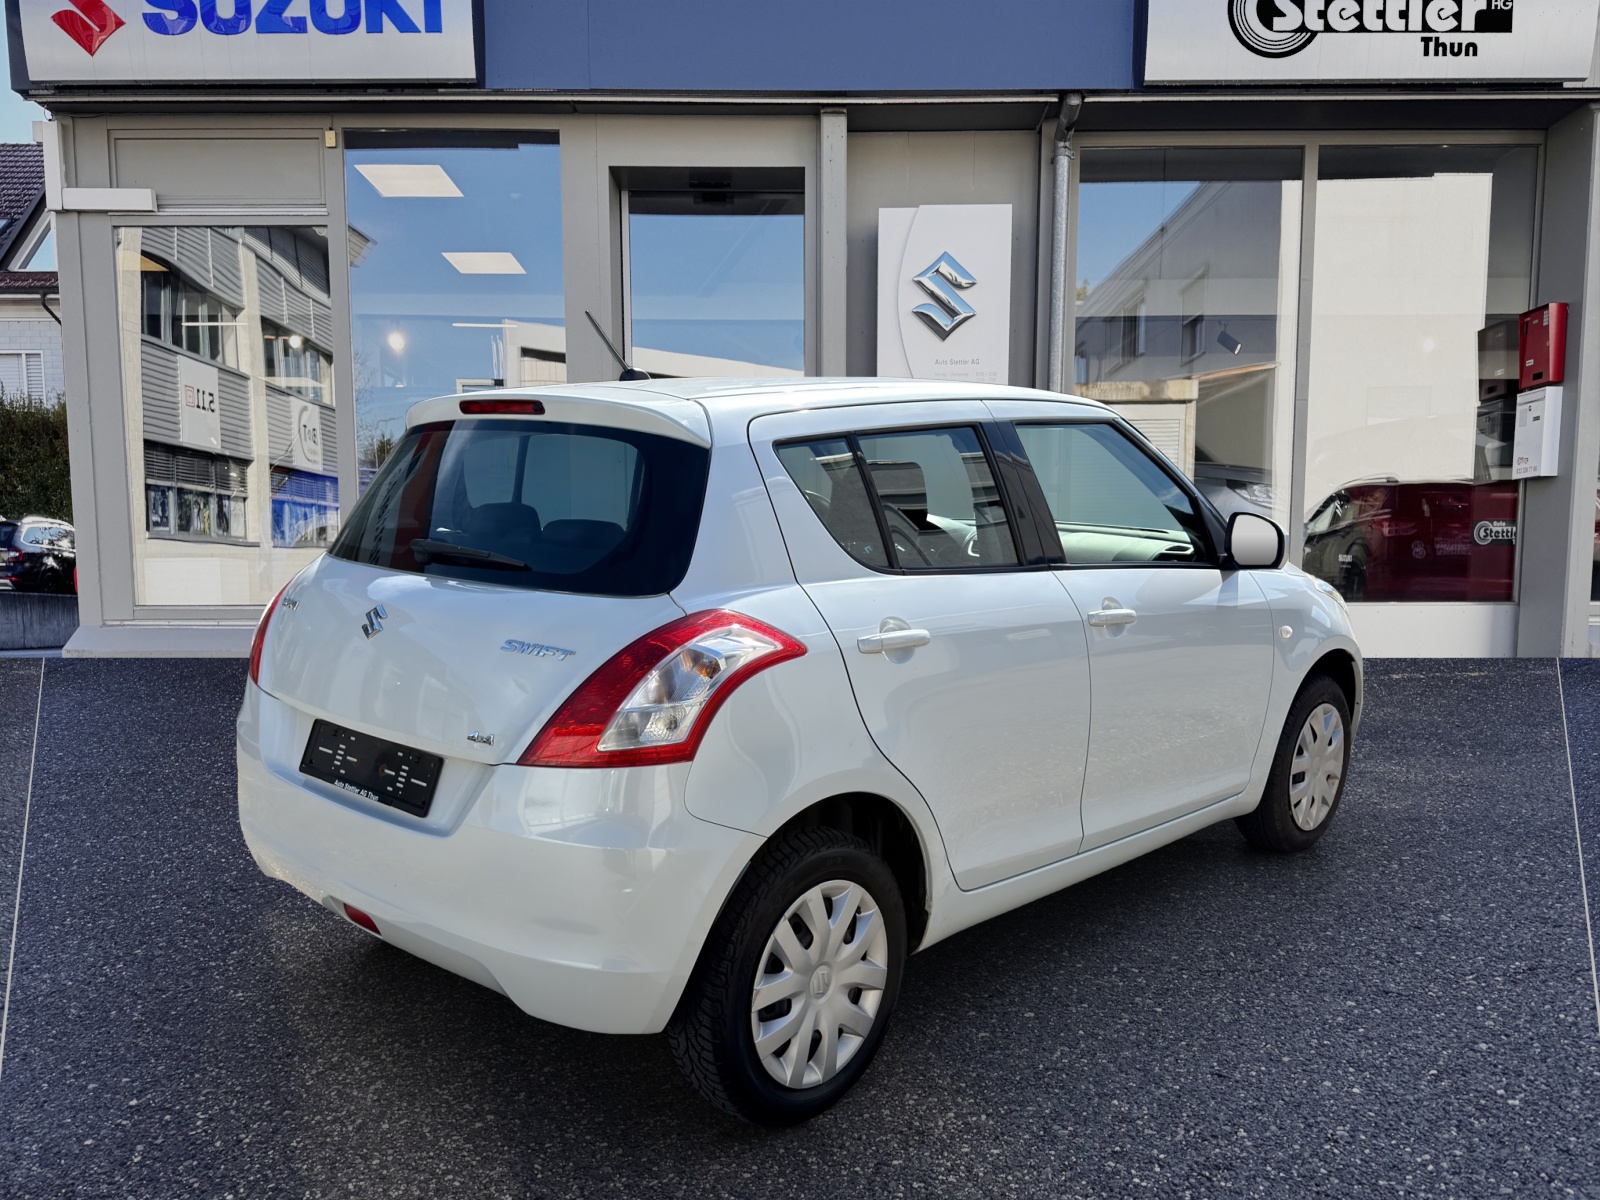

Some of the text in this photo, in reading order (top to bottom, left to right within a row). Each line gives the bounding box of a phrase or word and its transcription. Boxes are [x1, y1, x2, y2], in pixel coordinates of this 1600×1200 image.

[142, 0, 442, 35] SUZUKI
[1272, 0, 1488, 32] Stettler
[1420, 36, 1478, 57] Thun
[934, 358, 980, 366] Auto Stettler AG
[500, 639, 577, 661] SWIFT
[334, 779, 379, 801] Auto Stettler AG Thun
